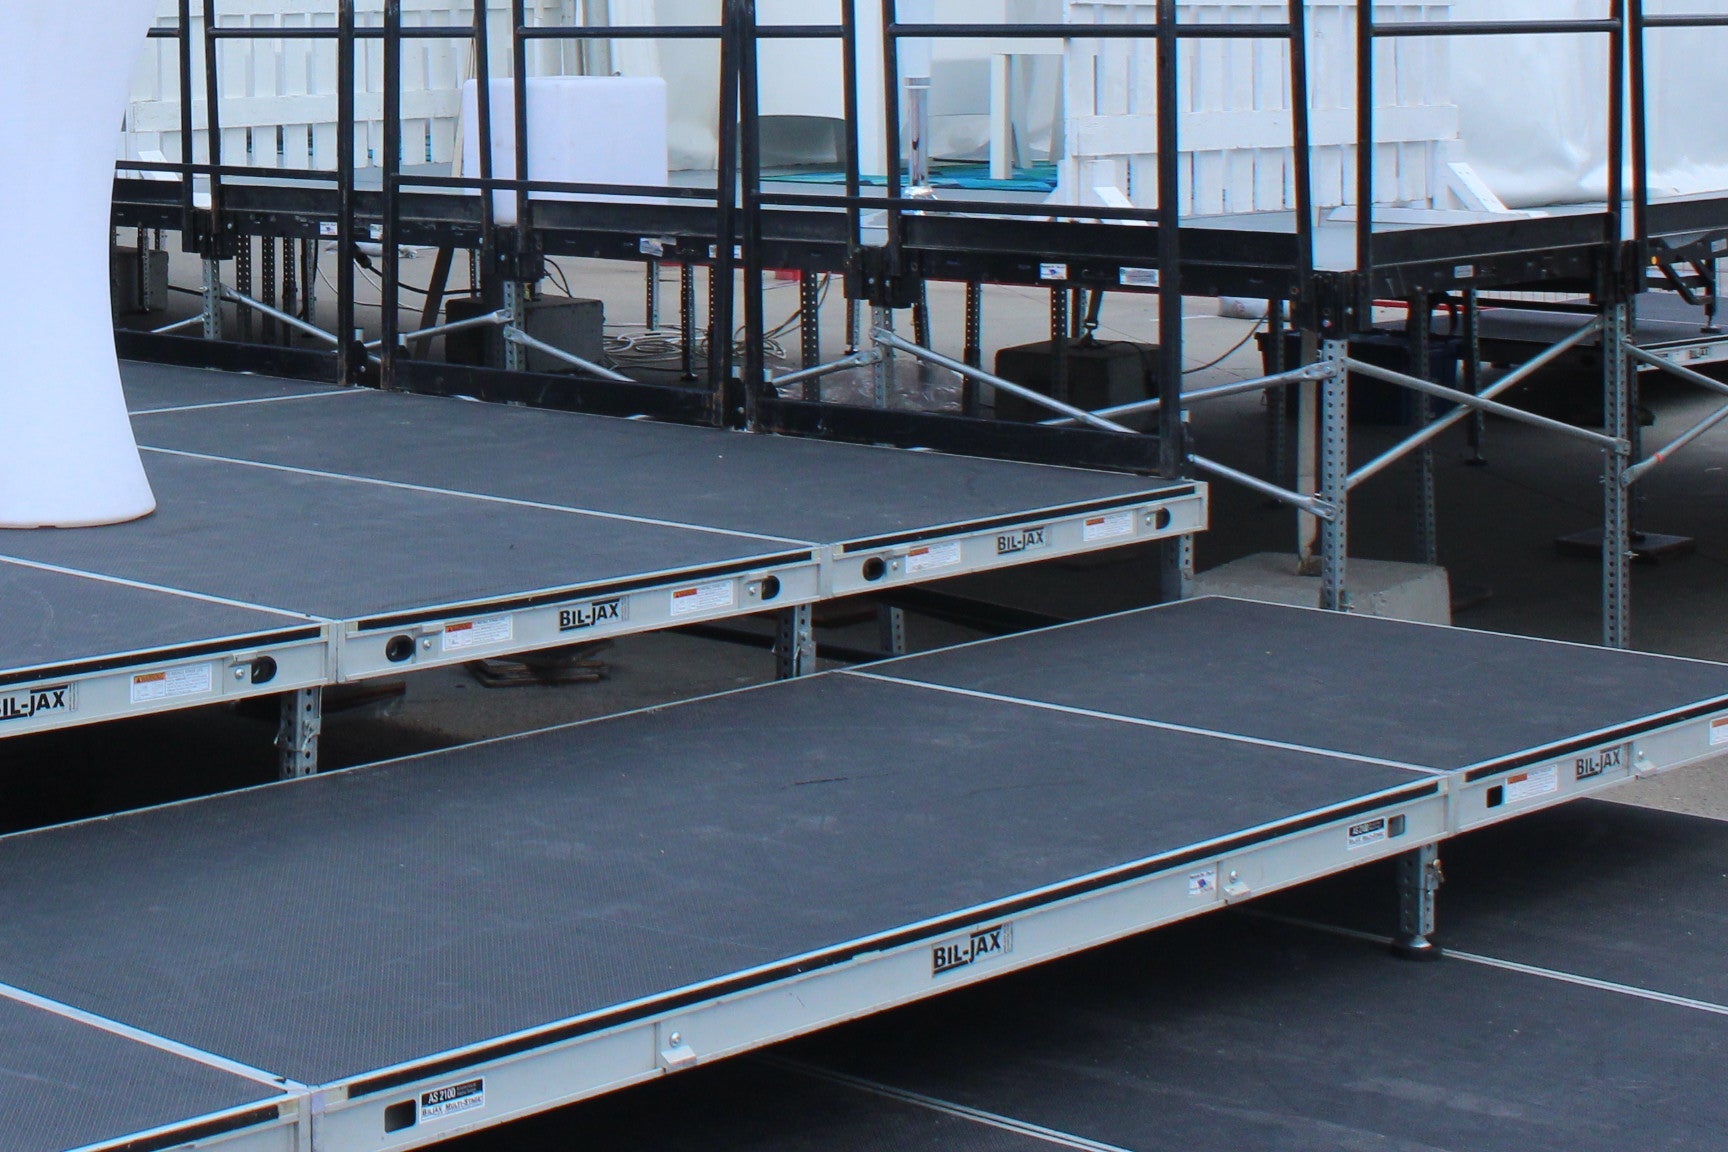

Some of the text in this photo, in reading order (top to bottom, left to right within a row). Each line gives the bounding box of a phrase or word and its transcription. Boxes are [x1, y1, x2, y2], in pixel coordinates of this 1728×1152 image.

[997, 530, 1044, 551] BIL-JAX
[559, 602, 619, 627] BIL-JAX
[1576, 748, 1620, 776] BIL-JAX
[933, 931, 1001, 968] BIL-JAX
[428, 1092, 439, 1105] AS
[439, 1087, 457, 1102] 2100
